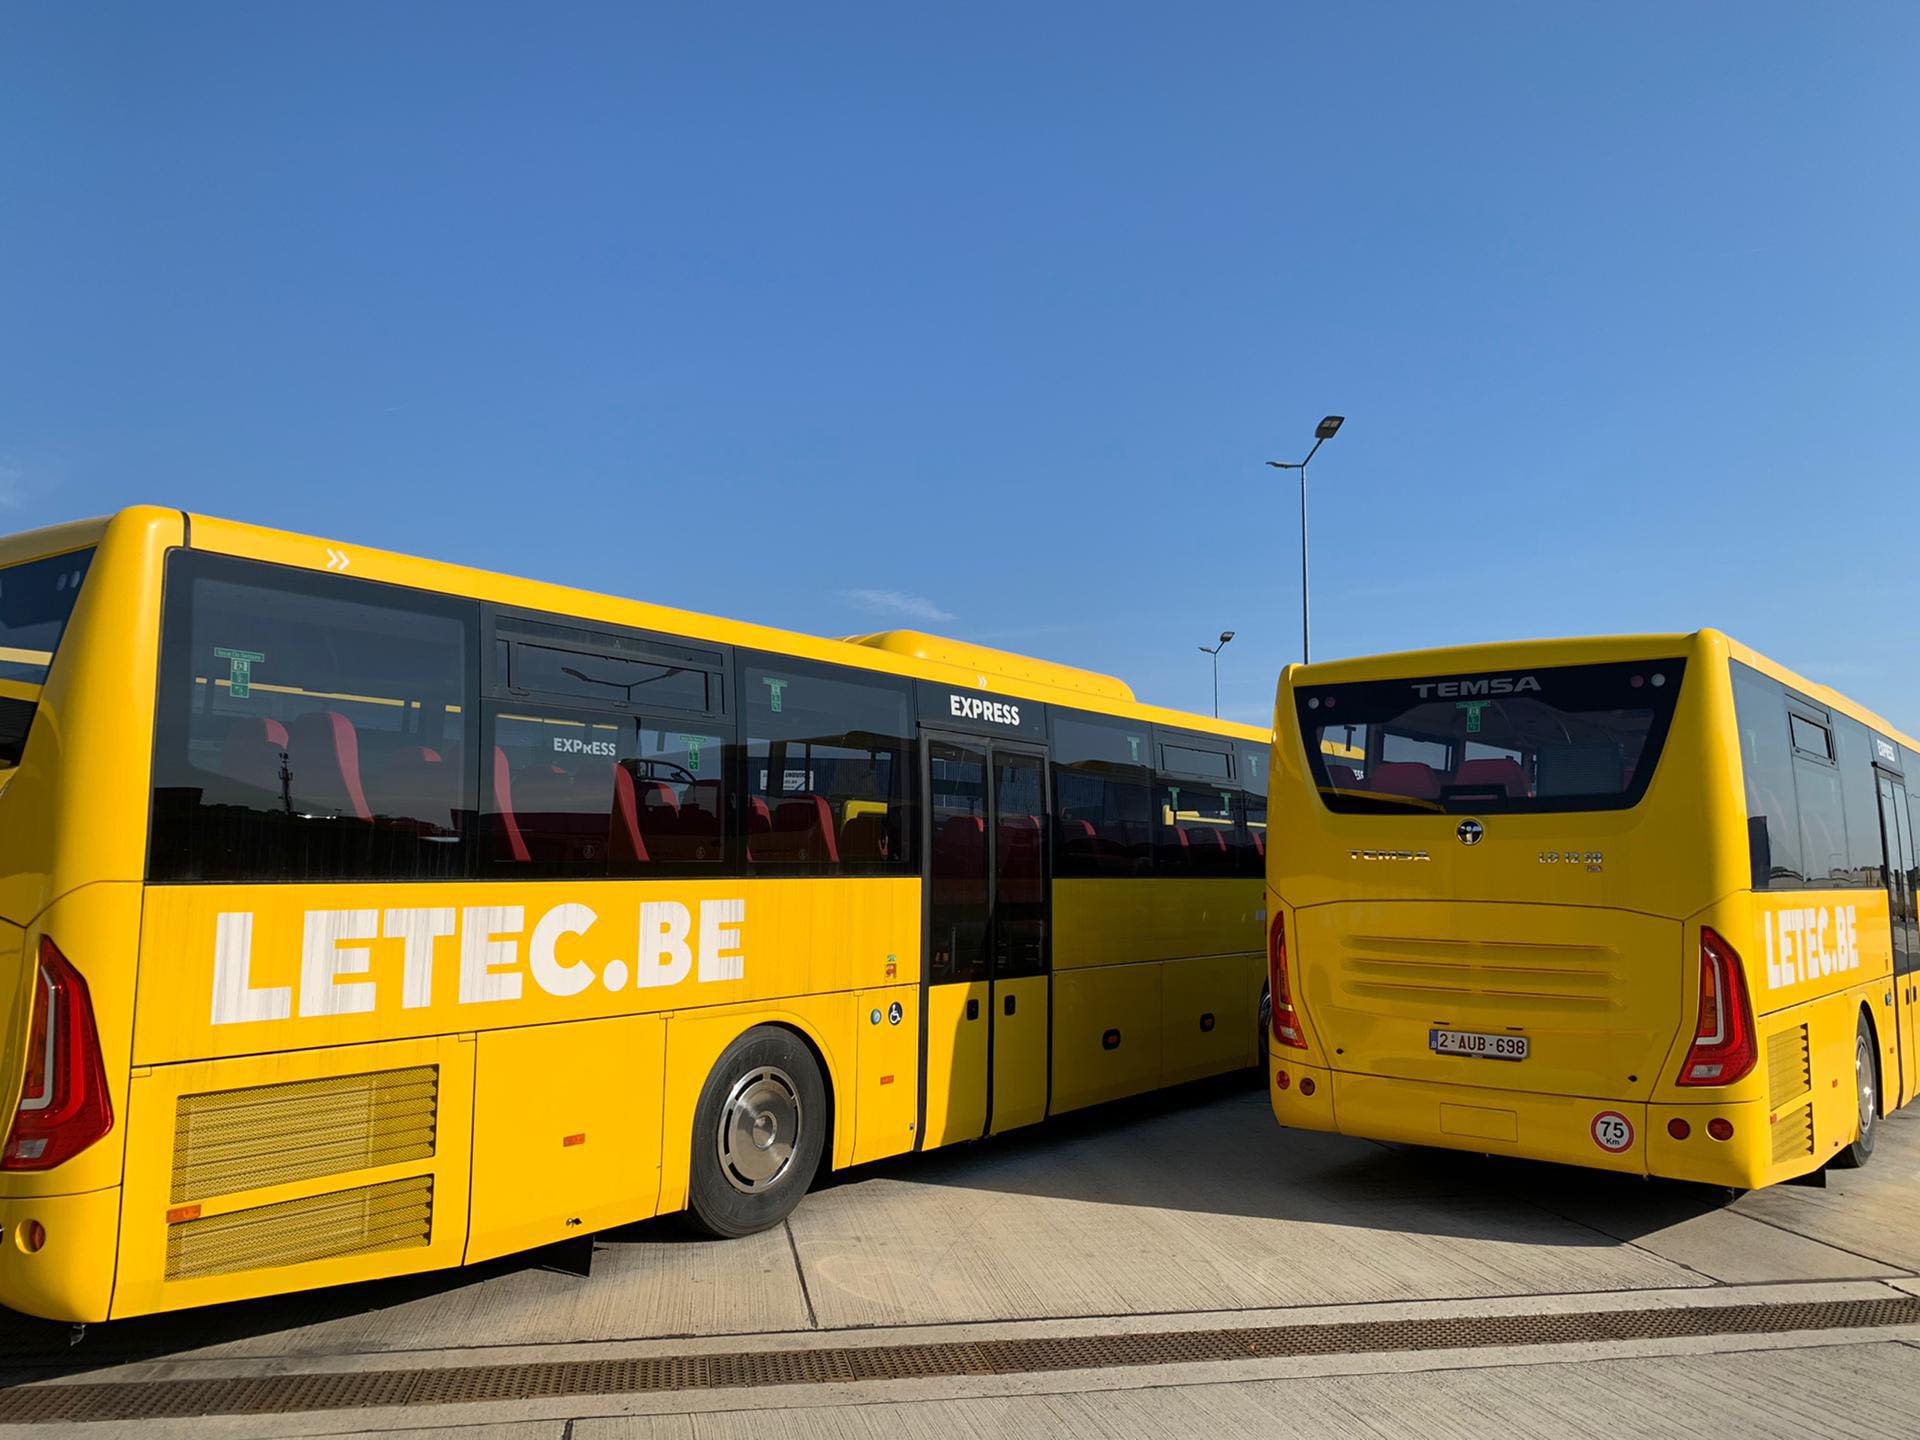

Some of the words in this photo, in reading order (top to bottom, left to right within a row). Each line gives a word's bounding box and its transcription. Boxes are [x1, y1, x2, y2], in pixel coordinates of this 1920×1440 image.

[1411, 676, 1542, 699] TEMSA
[950, 694, 1021, 726] EXPRESS
[1346, 849, 1431, 861] TEMSA
[1764, 905, 1860, 990] LETEC.BE
[210, 899, 745, 1025] LETEC.BE
[1600, 1120, 1625, 1139] 75
